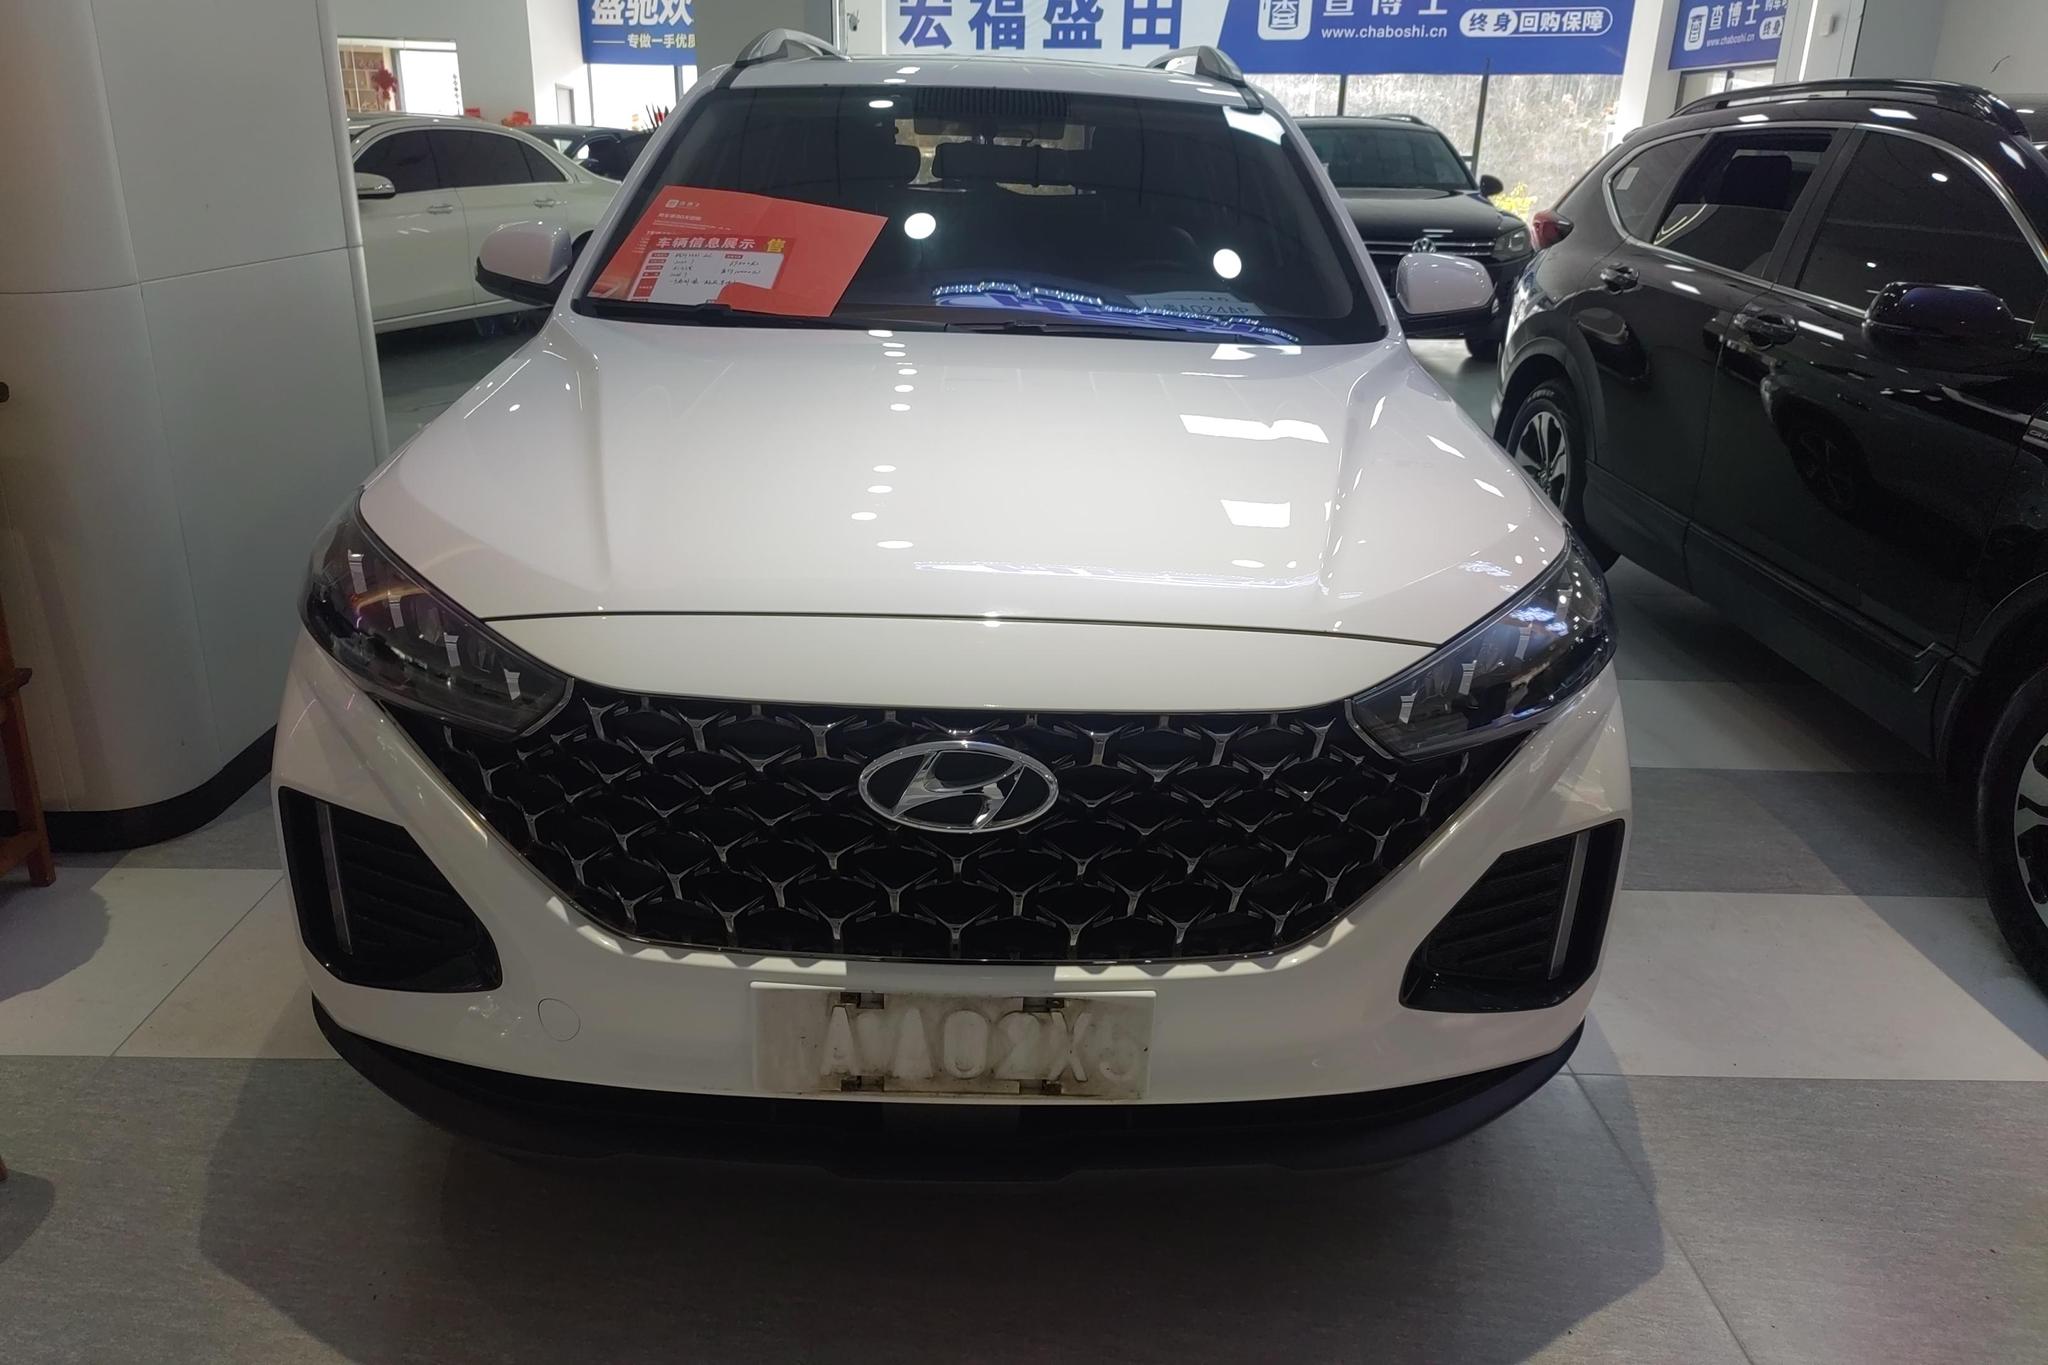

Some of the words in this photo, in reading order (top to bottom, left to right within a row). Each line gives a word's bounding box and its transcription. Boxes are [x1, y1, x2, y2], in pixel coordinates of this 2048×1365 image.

[1709, 0, 1760, 31] 查博士
[1321, 24, 1447, 39] www.chaboshi.cn
[657, 237, 756, 249] 车辆信息展示
